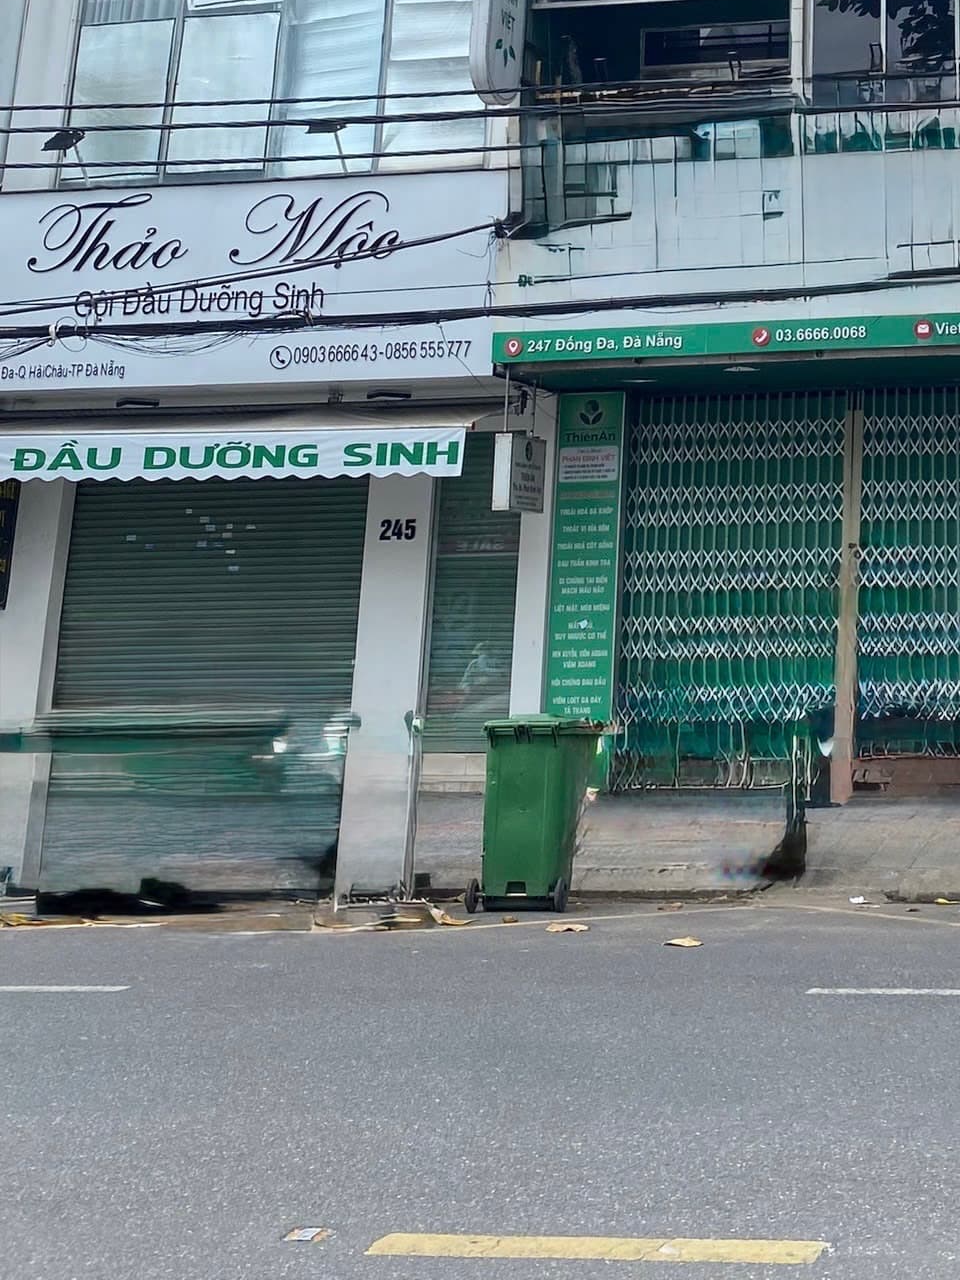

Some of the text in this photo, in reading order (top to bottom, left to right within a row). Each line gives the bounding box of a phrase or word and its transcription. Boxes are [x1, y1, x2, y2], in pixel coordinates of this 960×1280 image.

[27, 190, 402, 273] Thảo Mộc
[180, 282, 264, 318] Dưỡng
[272, 282, 325, 310] Sinh
[526, 331, 683, 353] 247 Đống Đa, Đà Nẵng
[775, 324, 867, 342] 03.6666.0068
[9, 439, 459, 471] ĐẦU DƯỠNG SINH
[379, 518, 417, 541] 245
